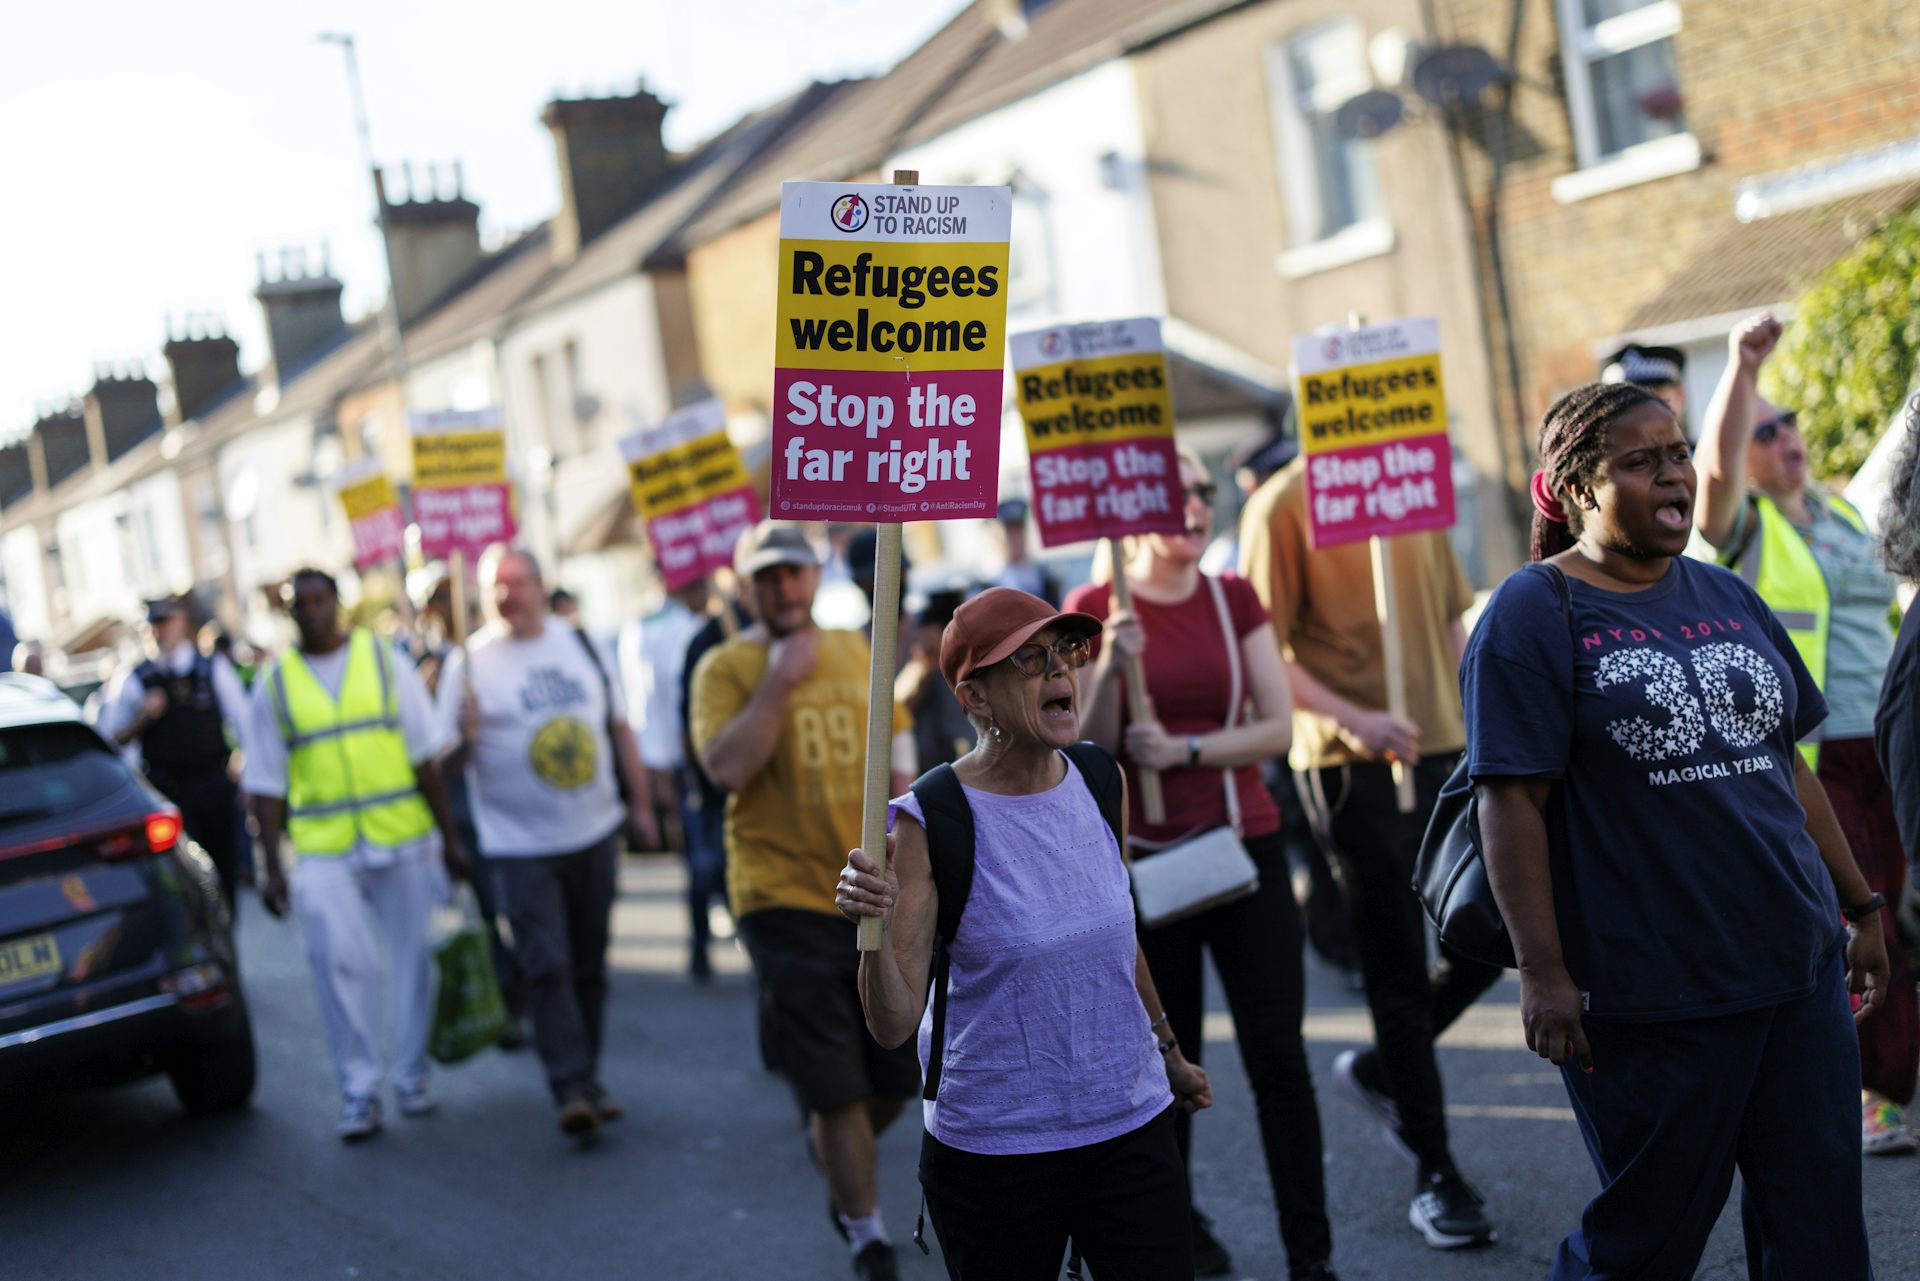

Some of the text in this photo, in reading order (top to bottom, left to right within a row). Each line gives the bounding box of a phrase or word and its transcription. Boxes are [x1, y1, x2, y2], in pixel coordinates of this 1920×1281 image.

[874, 195, 960, 214] STAND UP
[874, 216, 967, 235] TO RACISM
[792, 250, 999, 310] Refugees
[790, 308, 986, 353] welcome
[1023, 365, 1164, 403] Refugees
[1306, 365, 1438, 405] Refugees
[786, 381, 977, 440] Stop the
[1029, 402, 1163, 437] welcome
[1309, 402, 1433, 440] welcome
[785, 436, 853, 482] far
[866, 437, 972, 493] right
[1035, 445, 1167, 487] Stop the
[1311, 443, 1435, 489] Stop the
[792, 502, 863, 512] standuptoracismuk
[877, 503, 917, 512] @StandUTR
[929, 501, 987, 511] @AntiRacismDay
[1041, 482, 1170, 523] far right
[1314, 478, 1438, 526] far right
[1680, 618, 1742, 640] 2016
[1593, 640, 1785, 762] 30
[794, 705, 860, 769] 89
[1647, 755, 1774, 786] MAGICAL YEARS
